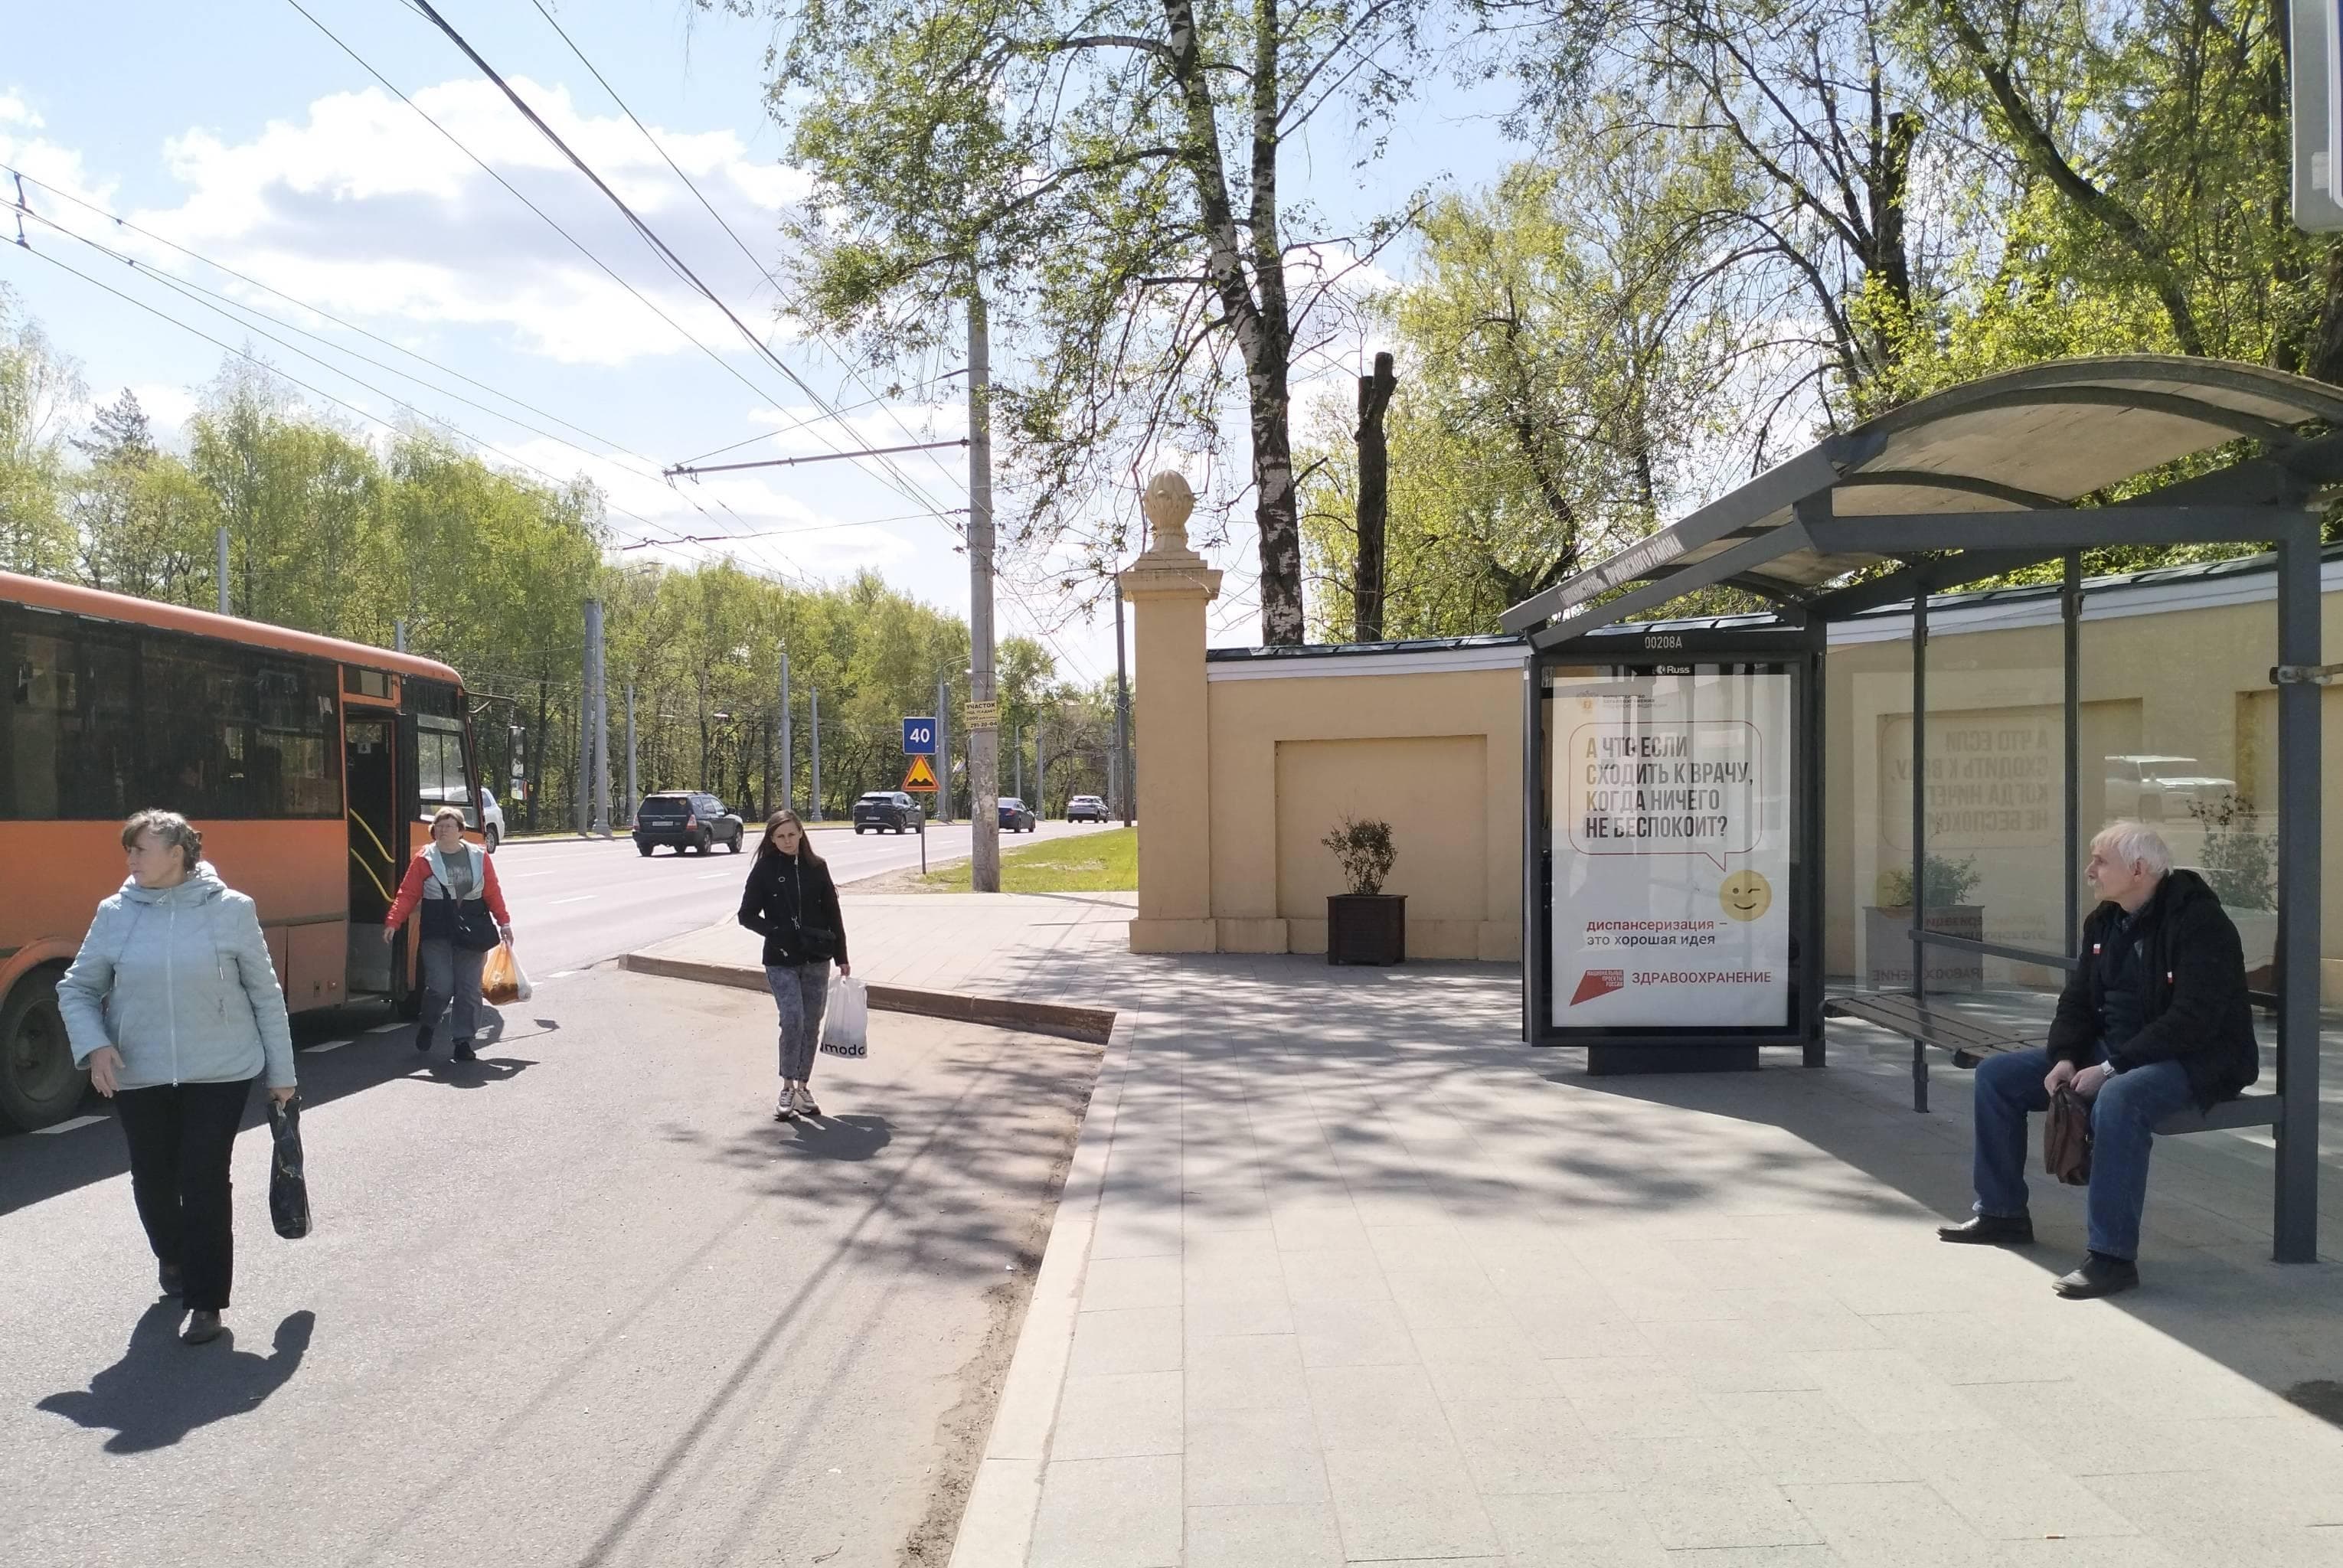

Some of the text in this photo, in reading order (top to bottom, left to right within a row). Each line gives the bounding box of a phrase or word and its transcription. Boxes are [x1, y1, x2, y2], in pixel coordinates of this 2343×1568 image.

[1647, 534, 1685, 564] РАЙОНА
[1667, 665, 1690, 674] Russ
[910, 728, 930, 743] 40
[1586, 736, 1688, 758] А ЧТО ЕСЛИ
[1586, 762, 1753, 786] СХОДИТЬ К ВРАЧУ,
[1586, 789, 1720, 813] КОГДА НИЧЕГО
[1586, 816, 1728, 838] НЕ БЕСПОКОИТ?
[1587, 920, 1714, 933] диспансеризация
[1587, 935, 1715, 946] это хорошая идея
[1632, 971, 1771, 985] ЗДРАВООХРАНЕНИЕ
